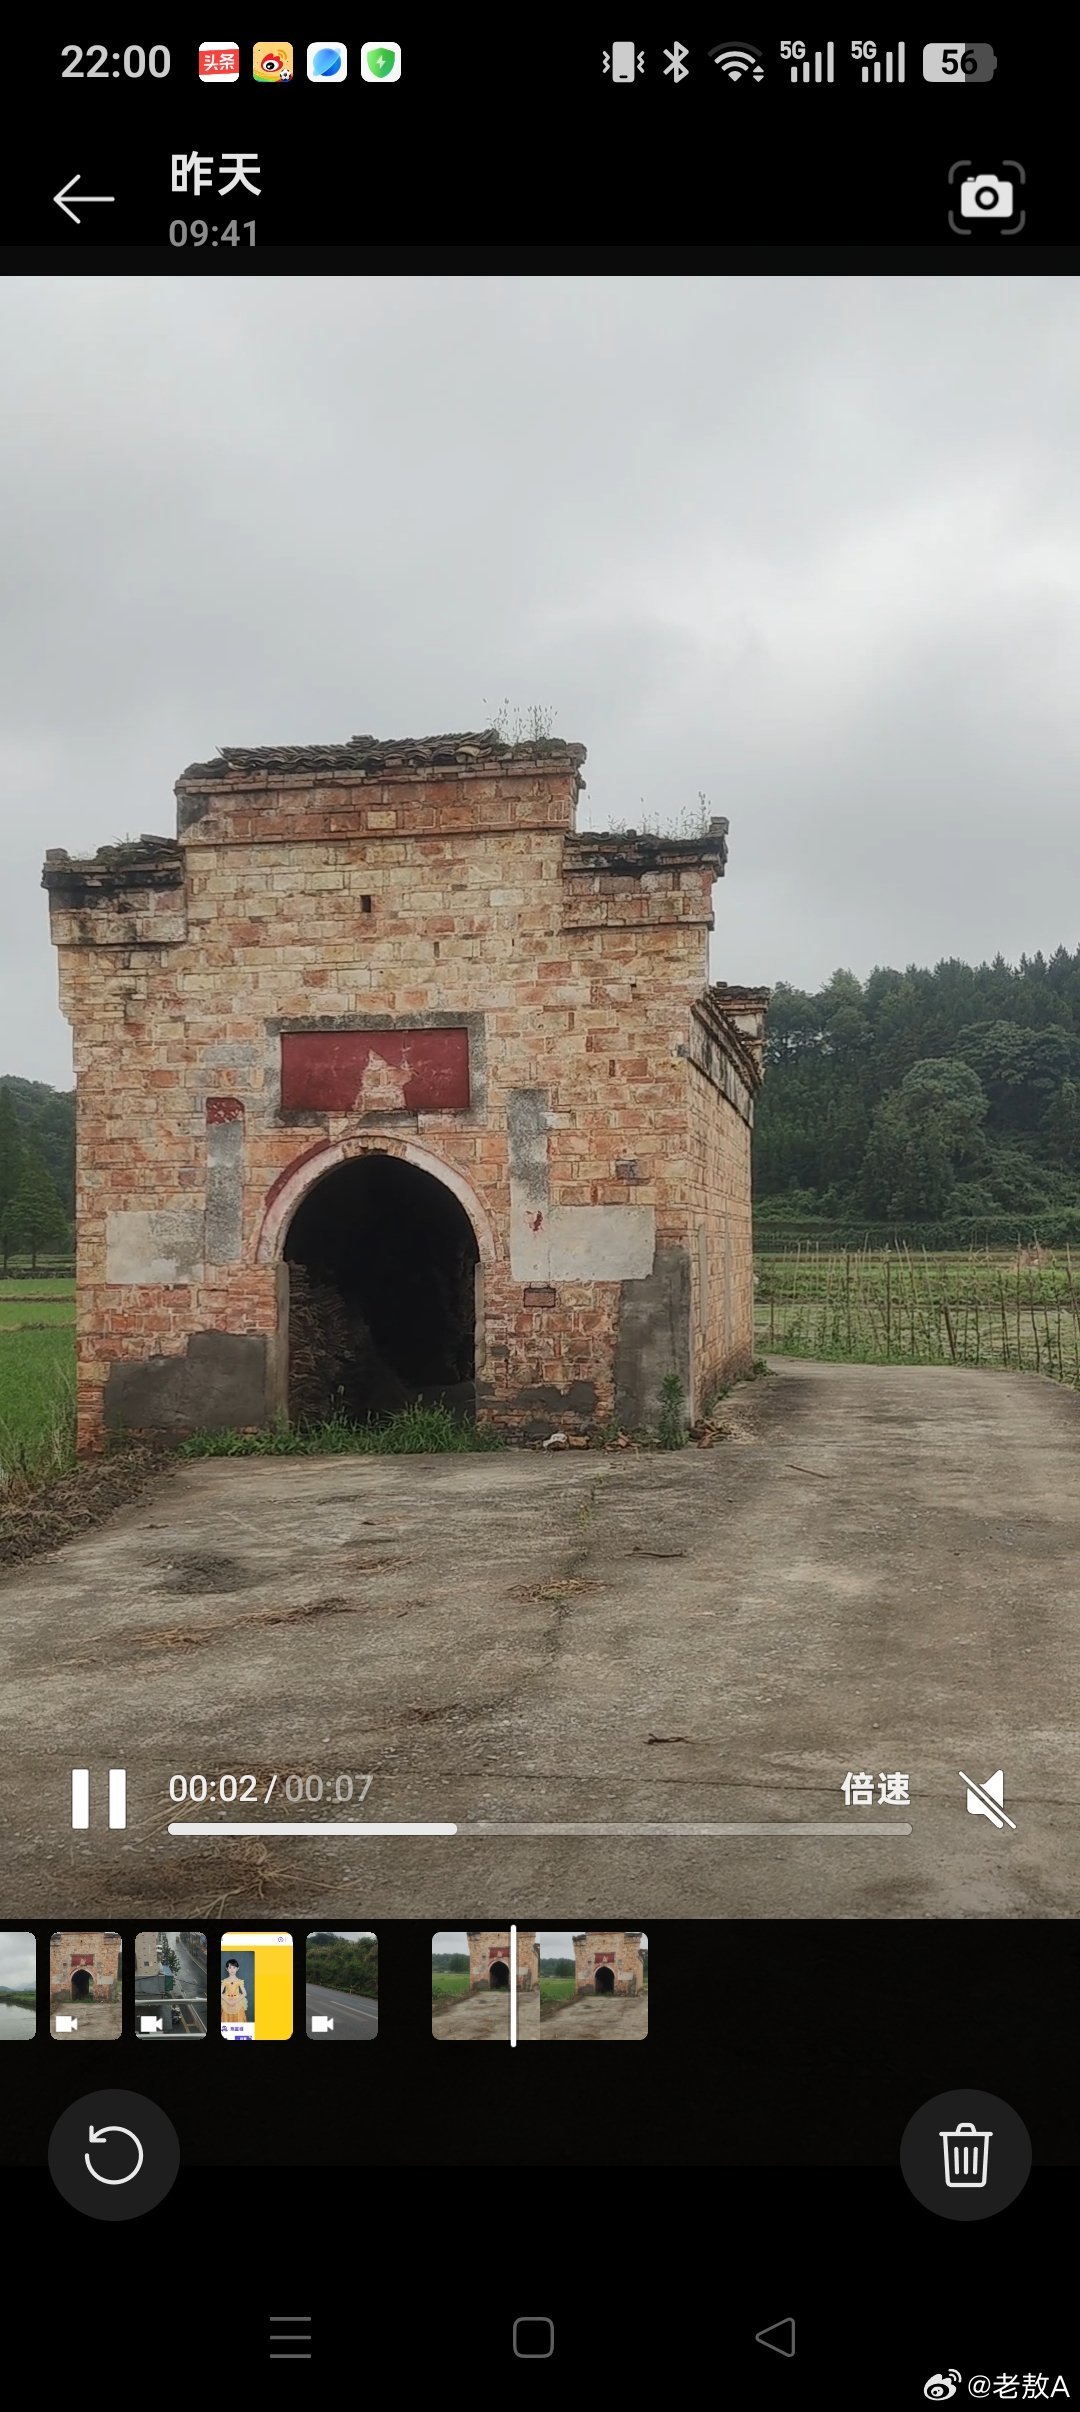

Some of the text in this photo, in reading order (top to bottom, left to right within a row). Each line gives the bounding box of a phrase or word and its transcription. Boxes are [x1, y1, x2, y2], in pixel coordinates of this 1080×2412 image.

[61, 44, 171, 79] 22:00
[203, 53, 235, 71] 头条
[780, 40, 806, 60] 5G
[851, 40, 877, 60] 5G
[941, 49, 978, 75] 56
[171, 151, 262, 196] 昨天
[168, 218, 258, 248] 09:41
[840, 1771, 911, 1806] 倍速
